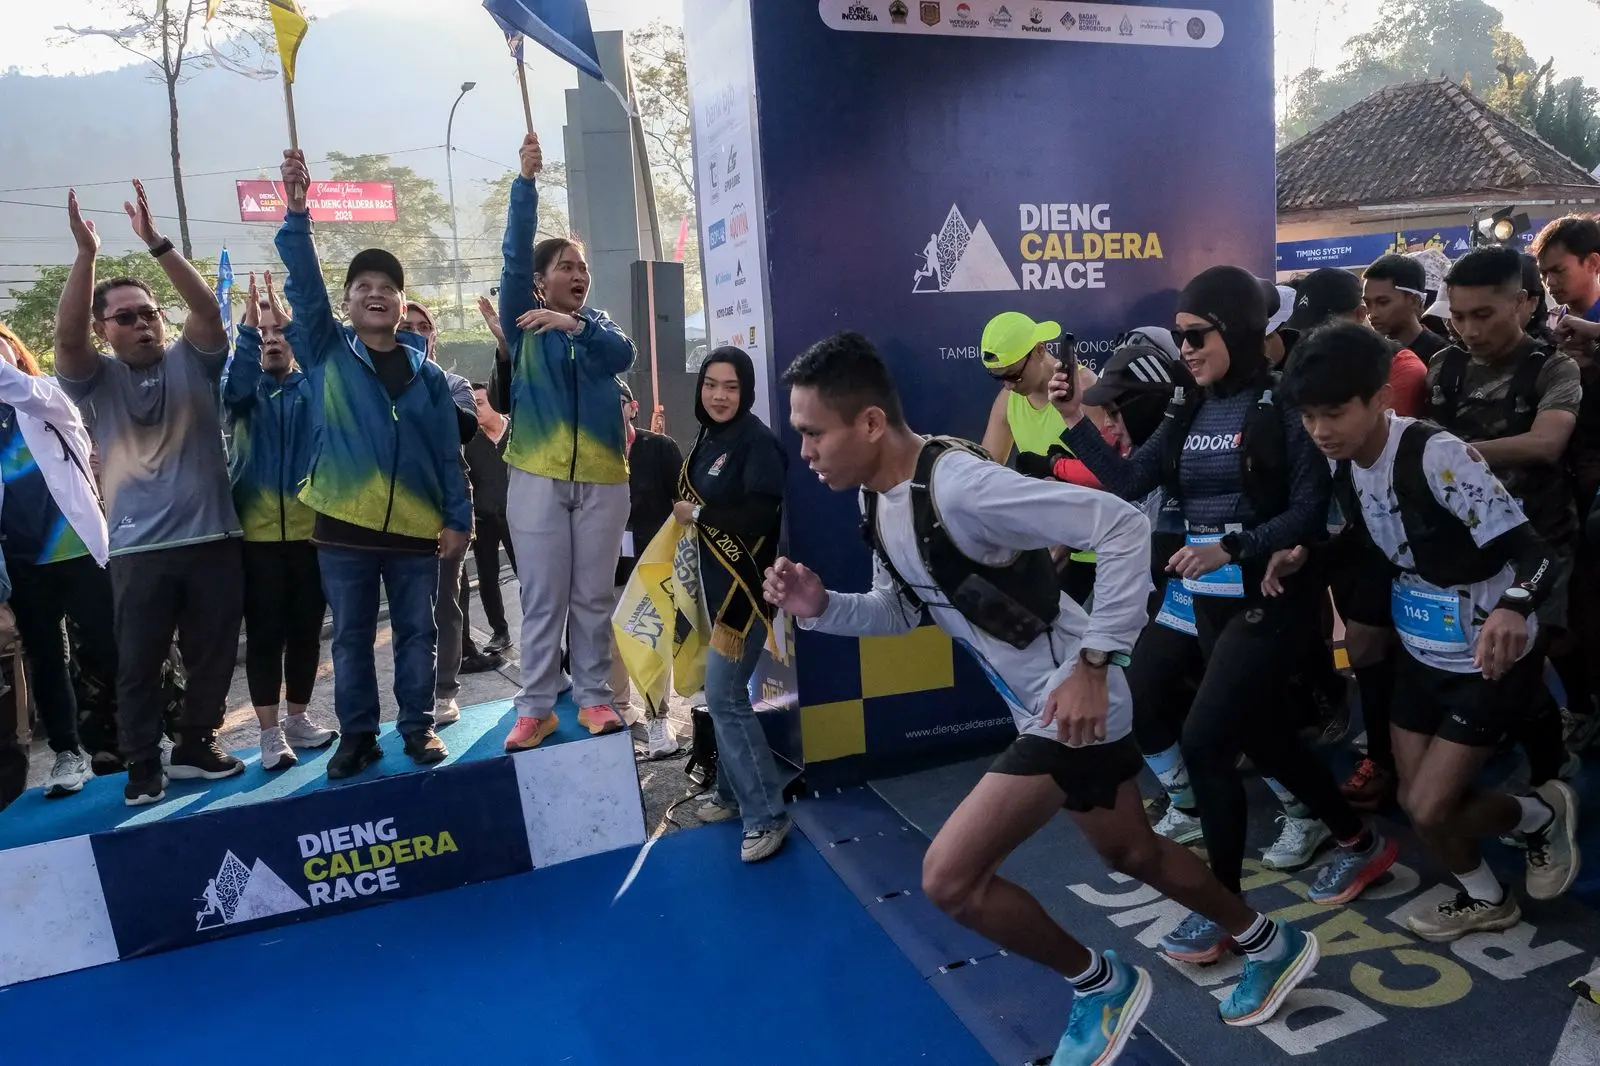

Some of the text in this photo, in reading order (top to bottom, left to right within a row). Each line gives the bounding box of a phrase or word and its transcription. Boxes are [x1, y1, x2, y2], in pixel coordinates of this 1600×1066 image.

[841, 12, 878, 21] INDONESIA
[1021, 24, 1052, 32] Perhutani
[317, 183, 340, 197] Selamat
[320, 199, 341, 209] DIENG
[342, 199, 374, 209] CALDERA
[375, 199, 394, 209] RACE
[1019, 203, 1111, 231] DIENG
[1019, 232, 1163, 260] CALDERA
[1295, 246, 1352, 258] TIMING SYSTEM
[1021, 262, 1106, 290] RACE
[939, 346, 980, 360] TAMBI
[716, 534, 743, 562] 2026
[1530, 558, 1550, 584] COROS
[1404, 605, 1430, 622] 1143
[905, 715, 1014, 739] www.diengcalderarace
[297, 816, 398, 859] DIENG
[303, 830, 458, 881] CALDERA
[308, 866, 400, 907] RACE
